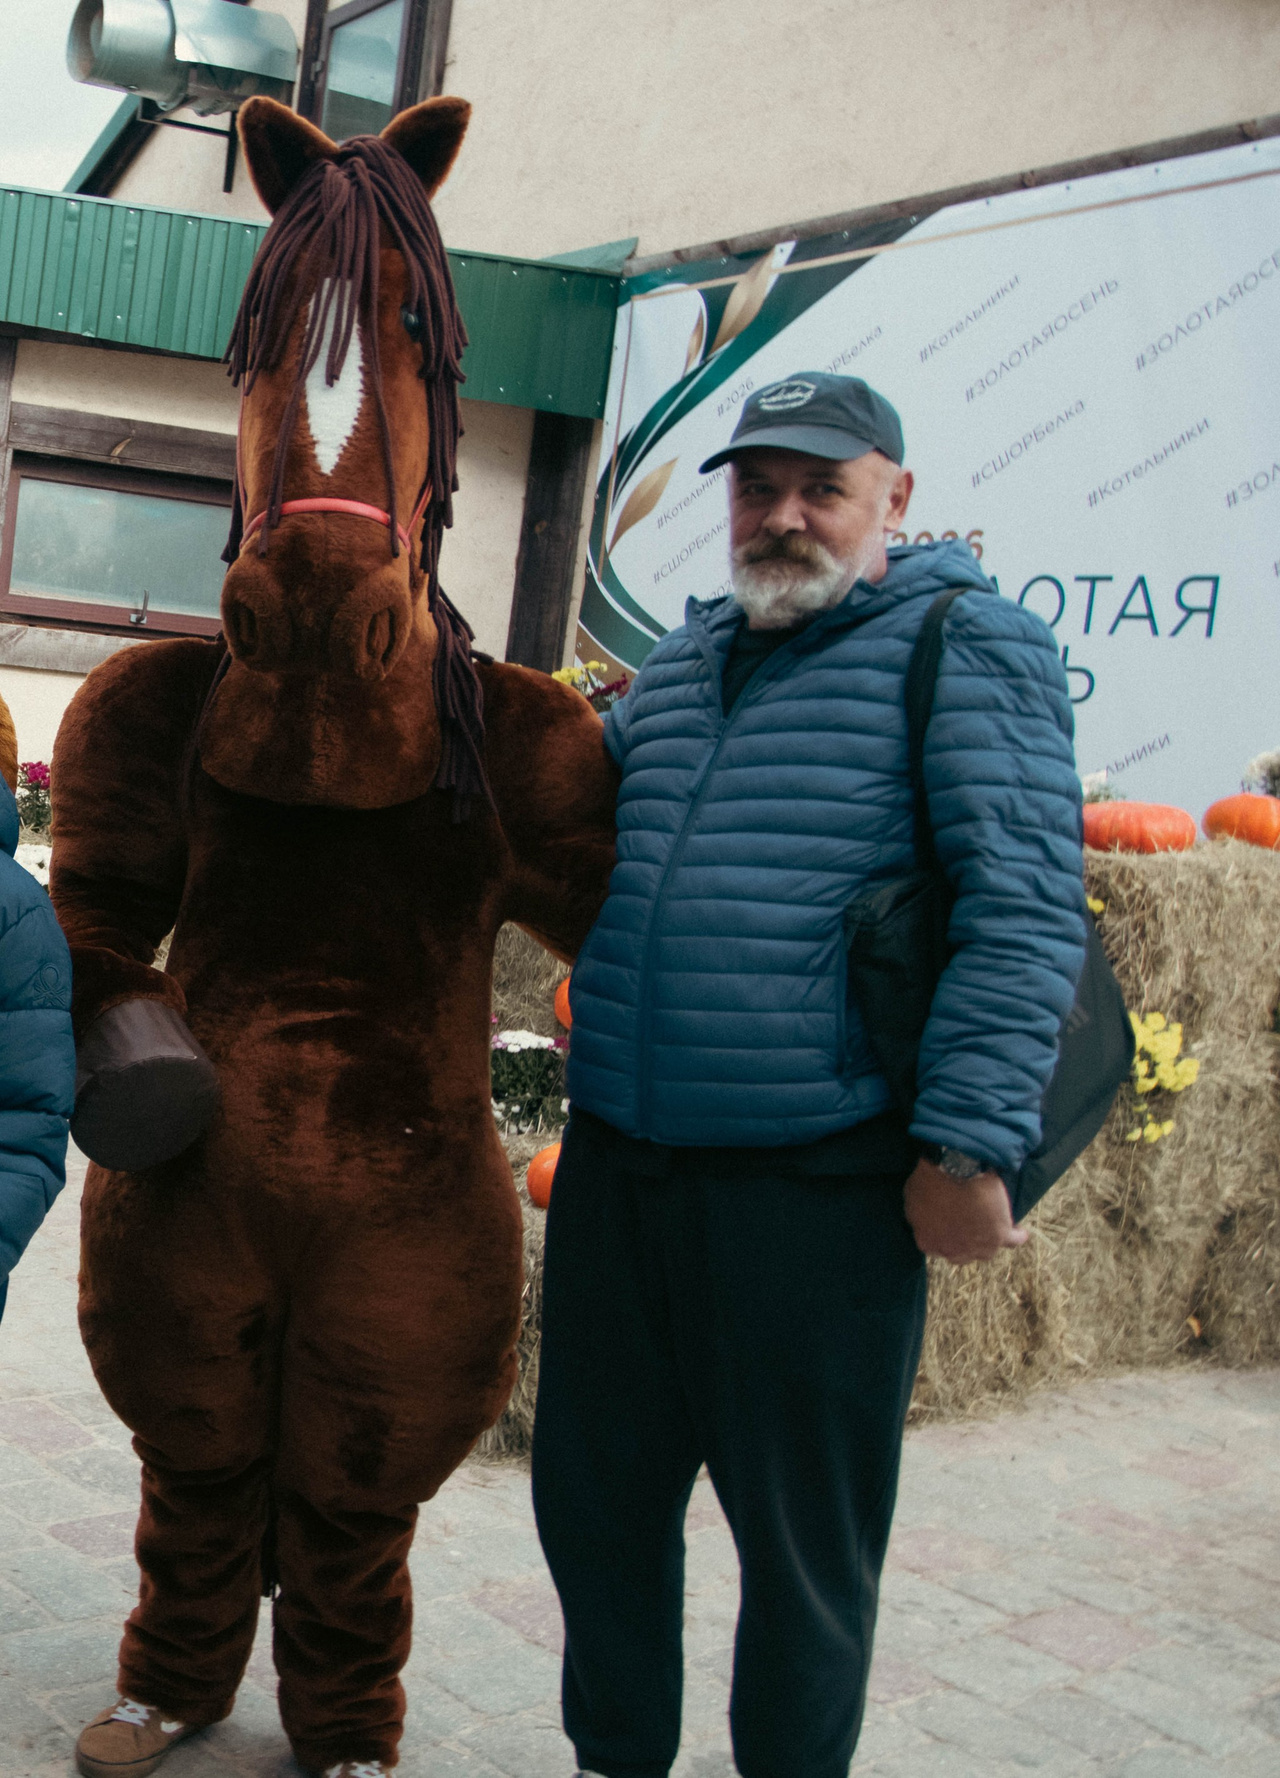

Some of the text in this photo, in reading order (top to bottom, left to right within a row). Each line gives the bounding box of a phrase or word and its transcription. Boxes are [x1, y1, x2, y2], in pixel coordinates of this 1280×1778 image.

[920, 275, 1020, 363] #Котельники
[965, 279, 1119, 402] #ЗОЛОТАЯОСЕНЬ
[971, 400, 1086, 489] #СШОРБелка
[1086, 417, 1211, 508] #Котельники
[990, 574, 1221, 639] ОТАЯ
